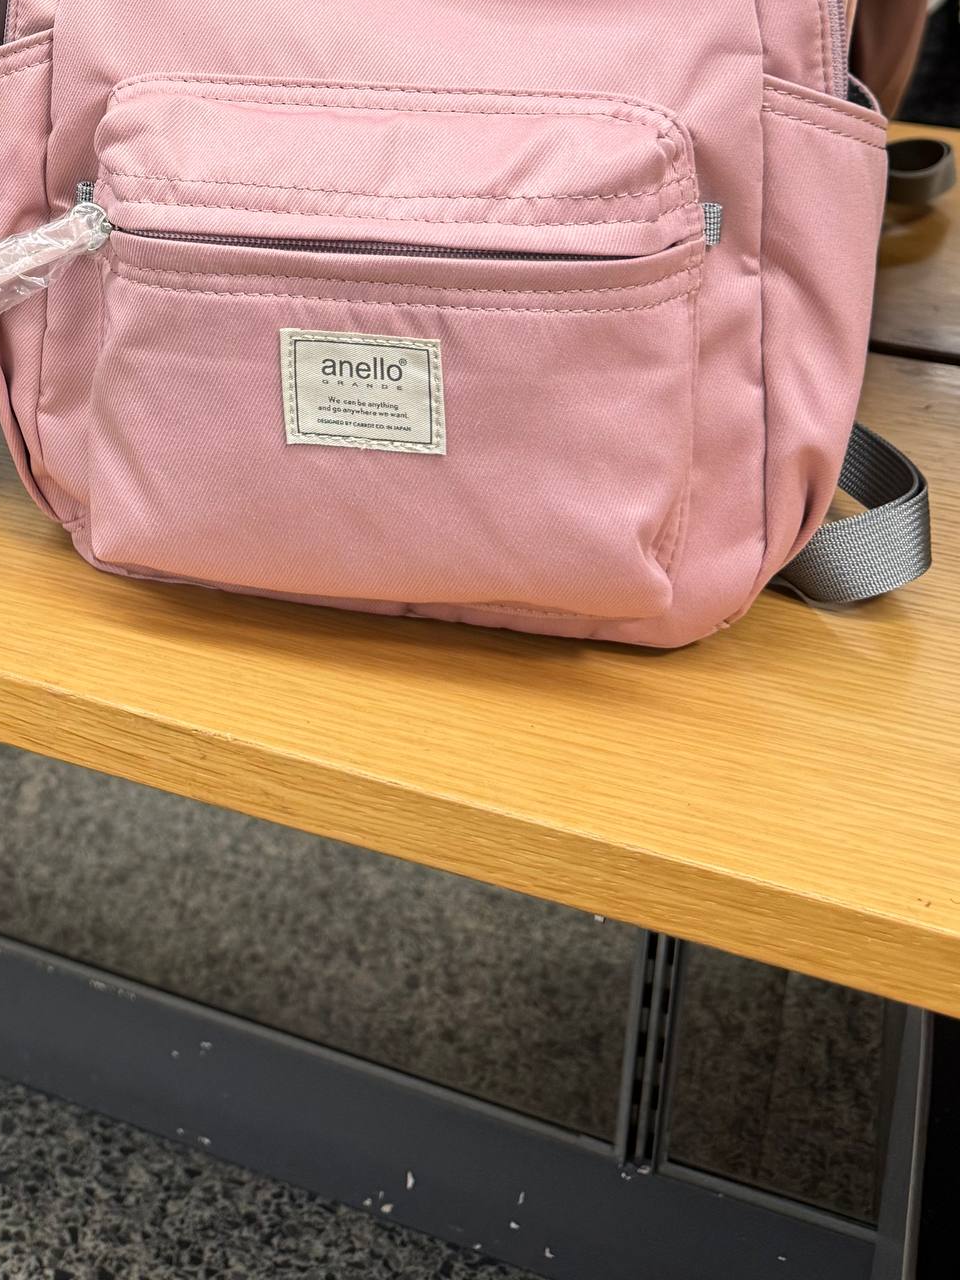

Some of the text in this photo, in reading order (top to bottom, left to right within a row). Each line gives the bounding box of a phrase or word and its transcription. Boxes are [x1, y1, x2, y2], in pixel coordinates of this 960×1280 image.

[327, 395, 341, 404] We
[357, 398, 367, 406] be
[367, 401, 399, 411] anything
[342, 408, 377, 416] anywhere
